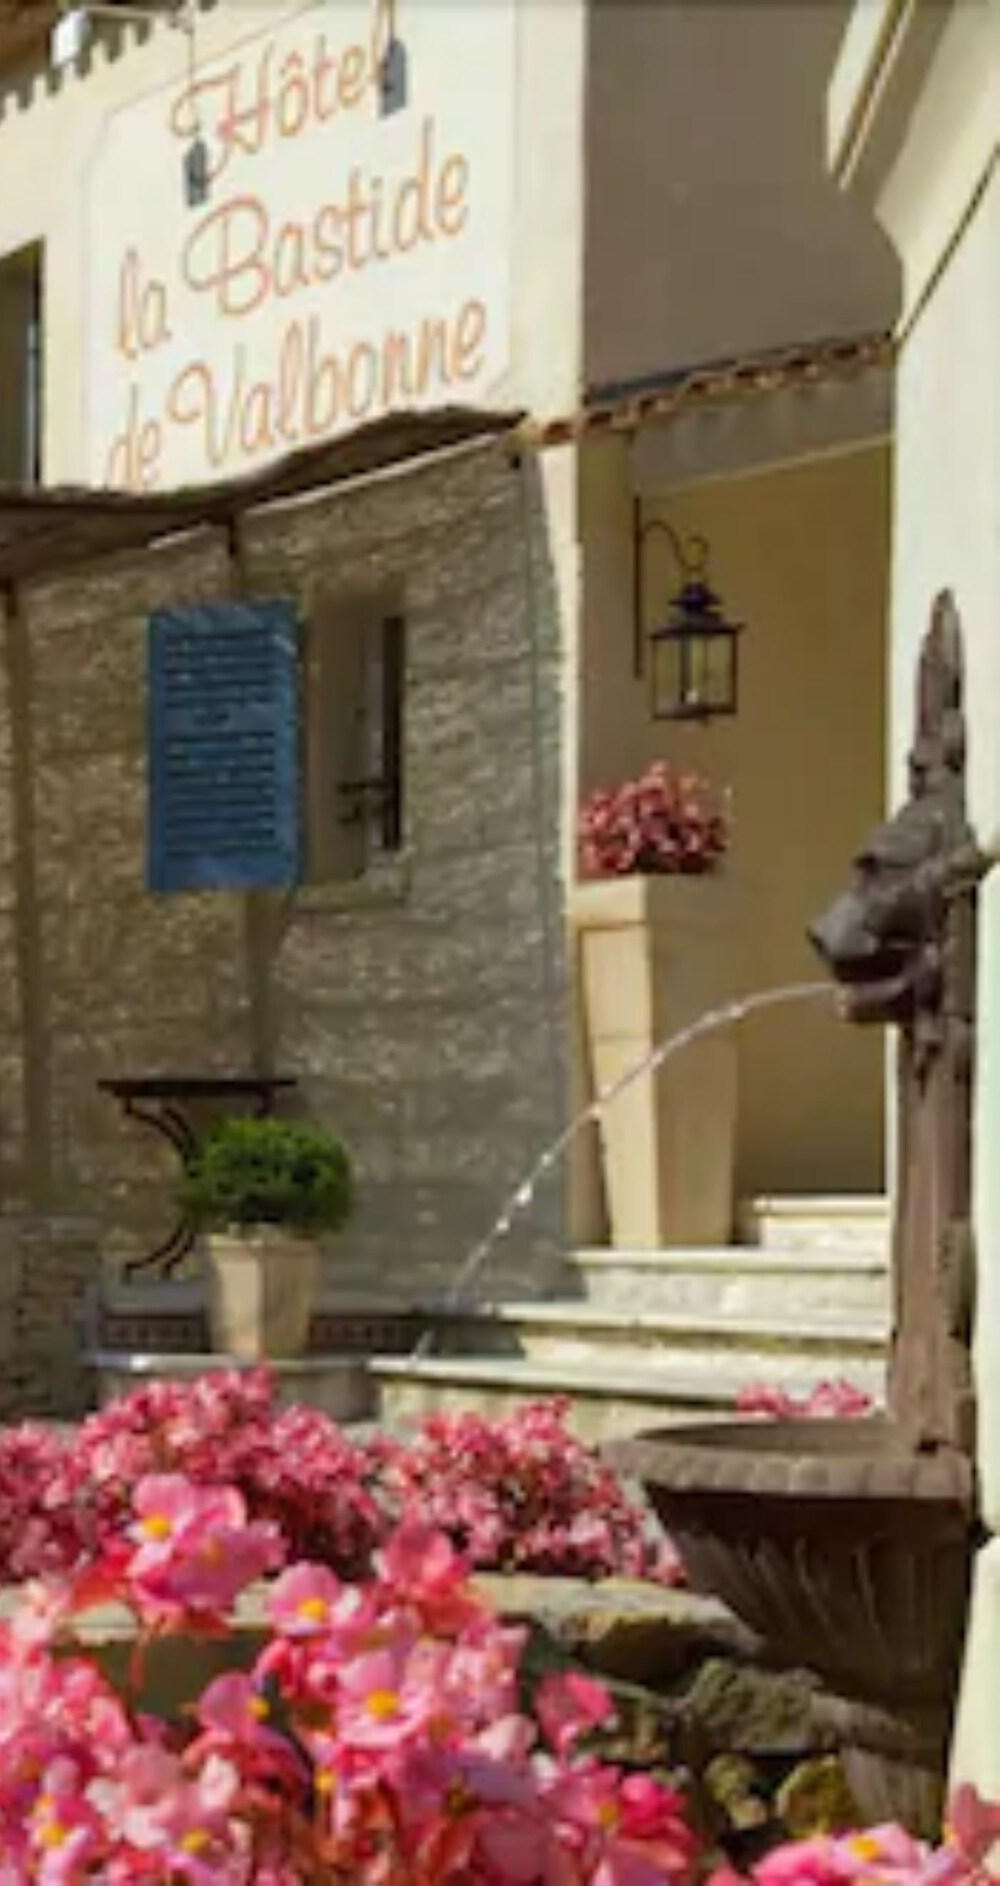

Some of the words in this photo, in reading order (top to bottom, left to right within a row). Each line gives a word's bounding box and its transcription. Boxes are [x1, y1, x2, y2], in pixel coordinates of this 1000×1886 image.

[170, 3, 391, 182] Hôtel
[117, 248, 171, 361] la
[182, 115, 469, 316] Bastide
[107, 383, 161, 494] de
[166, 299, 487, 467] Valbonne
